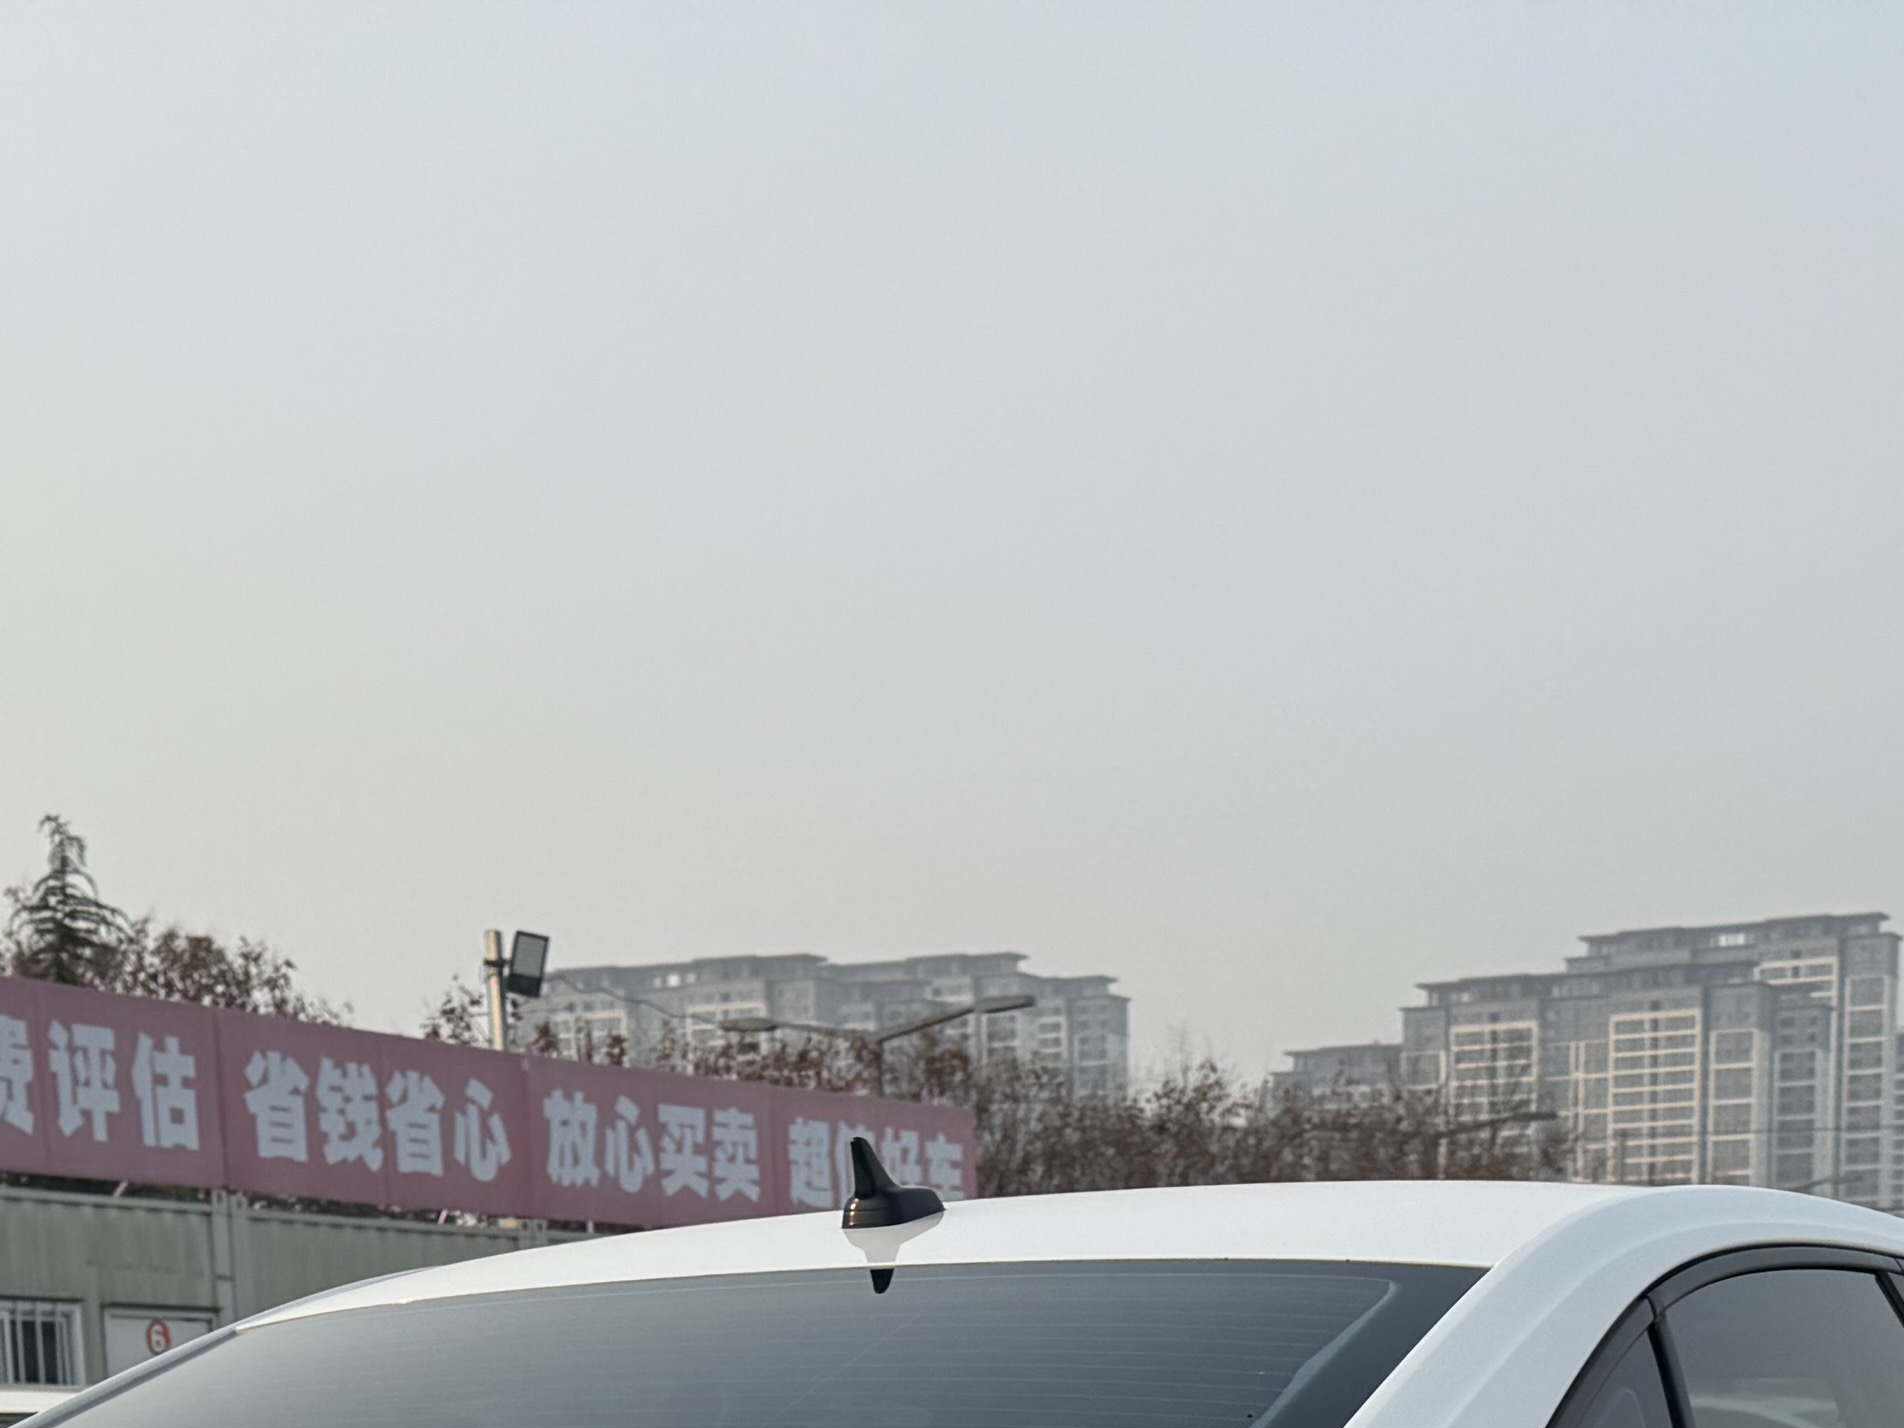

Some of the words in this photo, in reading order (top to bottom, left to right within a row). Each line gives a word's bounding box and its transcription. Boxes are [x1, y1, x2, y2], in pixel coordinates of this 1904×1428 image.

[244, 1050, 510, 1182] 省钱省心
[543, 1088, 761, 1202] 放心买卖
